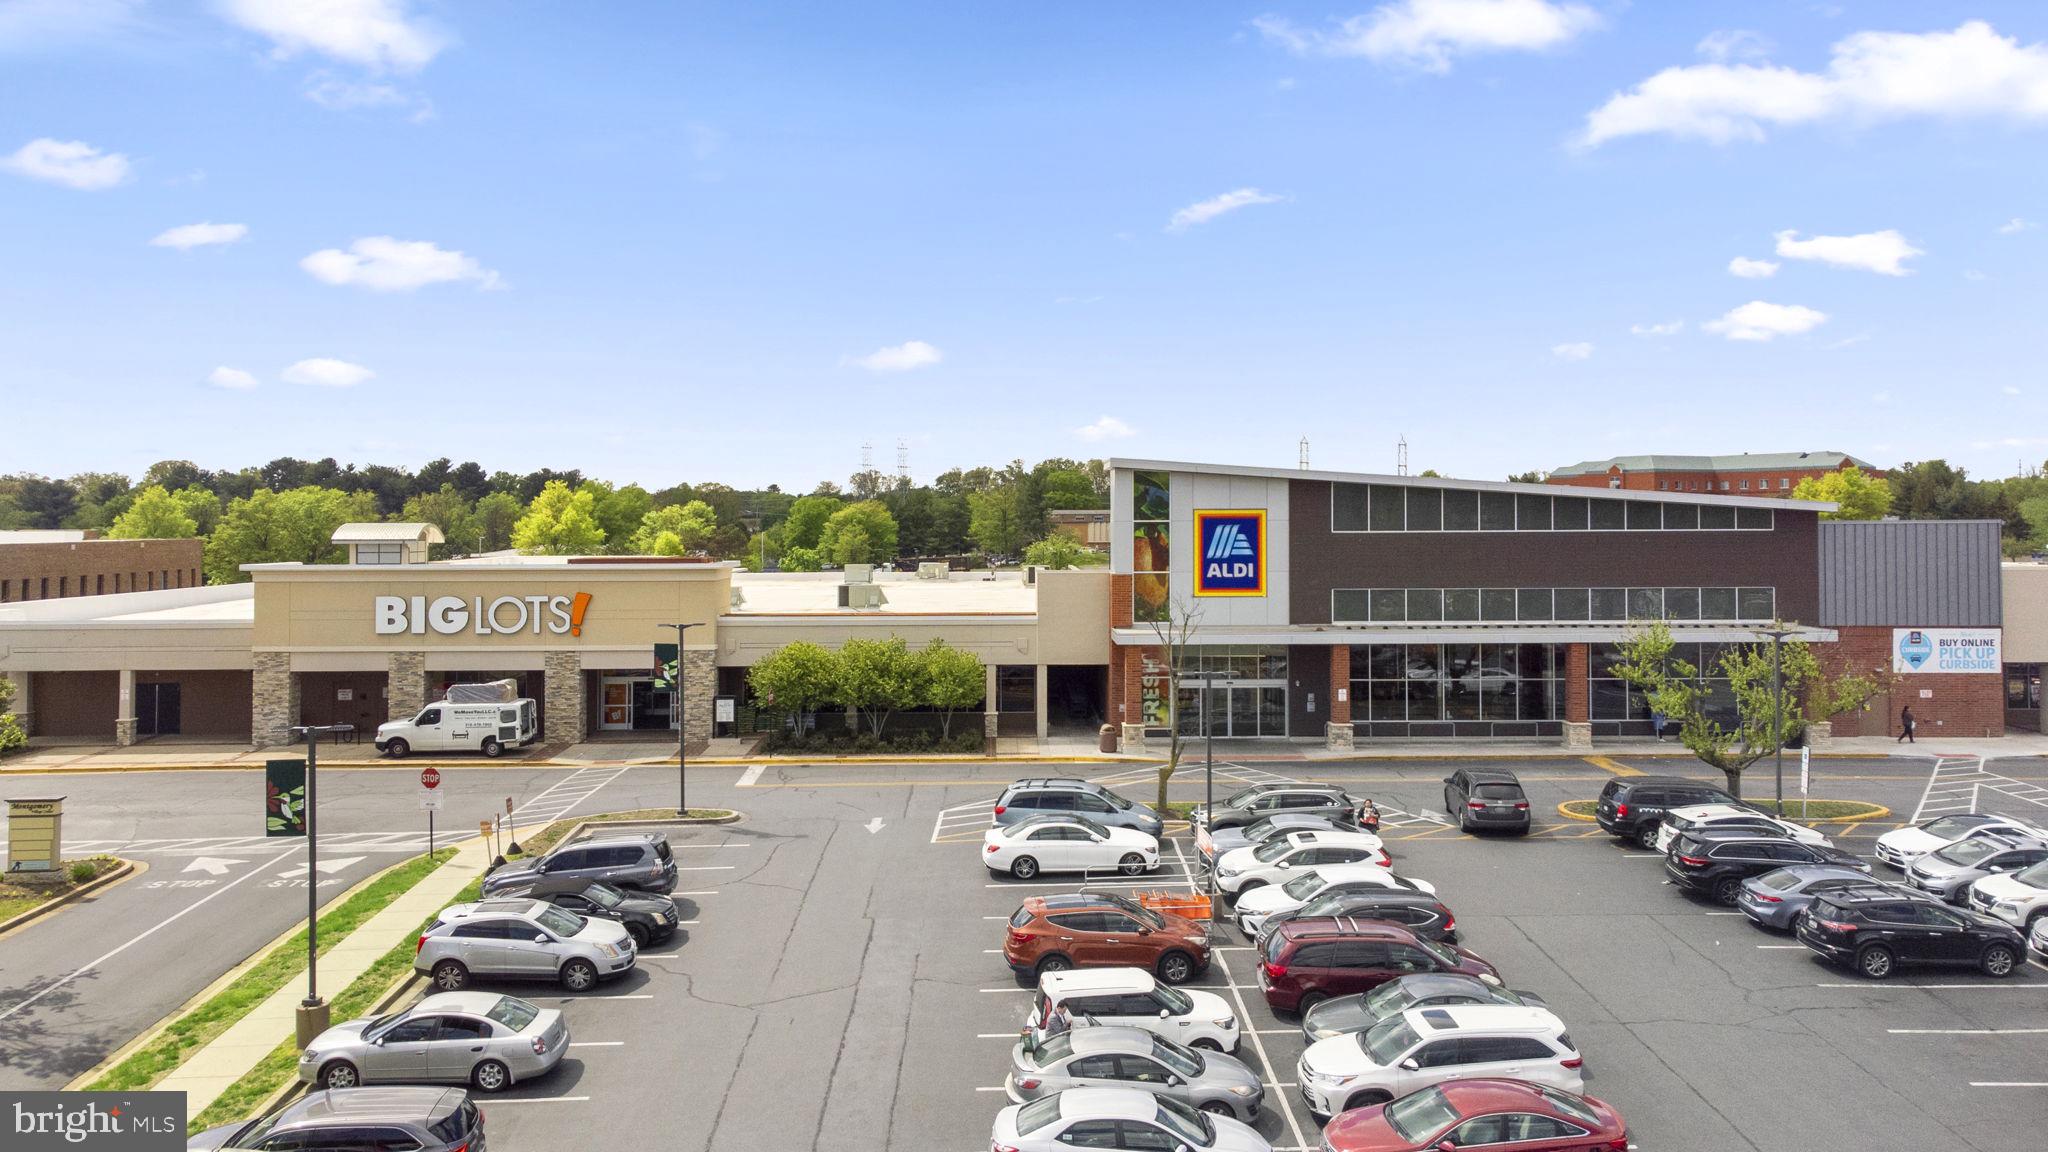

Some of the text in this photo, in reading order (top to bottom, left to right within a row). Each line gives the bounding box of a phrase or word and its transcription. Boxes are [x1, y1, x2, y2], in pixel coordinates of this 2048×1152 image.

[1206, 562, 1254, 578] ALDI
[375, 592, 593, 637] BIG LOTS!
[1939, 638, 1995, 647] BUY ONLINE
[1940, 647, 1996, 659] PICK UP
[1939, 660, 1996, 669] CURBSIDE
[1142, 656, 1160, 726] FRESH
[422, 774, 440, 783] STOP
[148, 879, 217, 889] STOP
